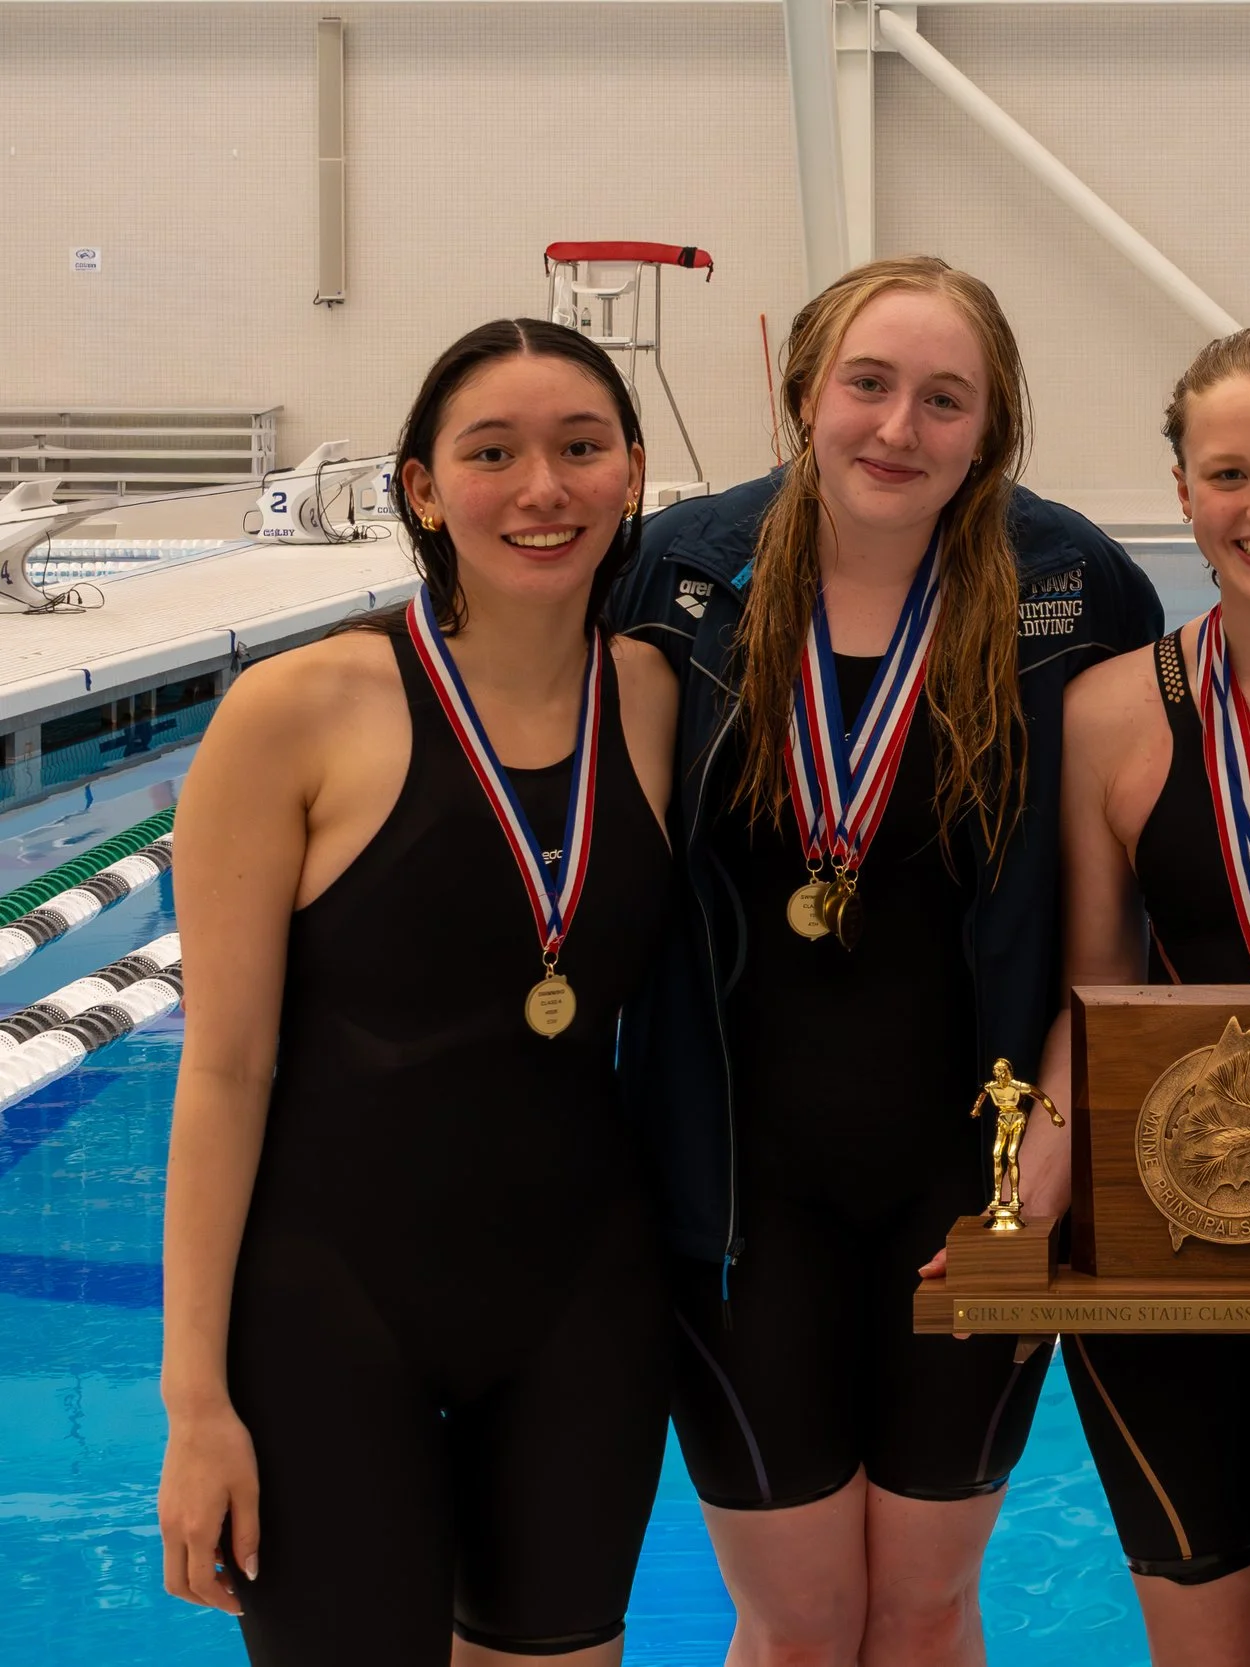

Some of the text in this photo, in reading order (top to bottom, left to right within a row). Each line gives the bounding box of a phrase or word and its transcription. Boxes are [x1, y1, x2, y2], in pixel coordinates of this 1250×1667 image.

[382, 473, 391, 493] 1
[270, 491, 287, 513] 2
[679, 579, 715, 597] are
[1018, 600, 1083, 620] IMMING
[1022, 618, 1075, 637] DIVING
[1141, 1109, 1161, 1169] MAINE
[1030, 1306, 1132, 1322] SWIMMING
[1138, 1306, 1193, 1322] STATE
